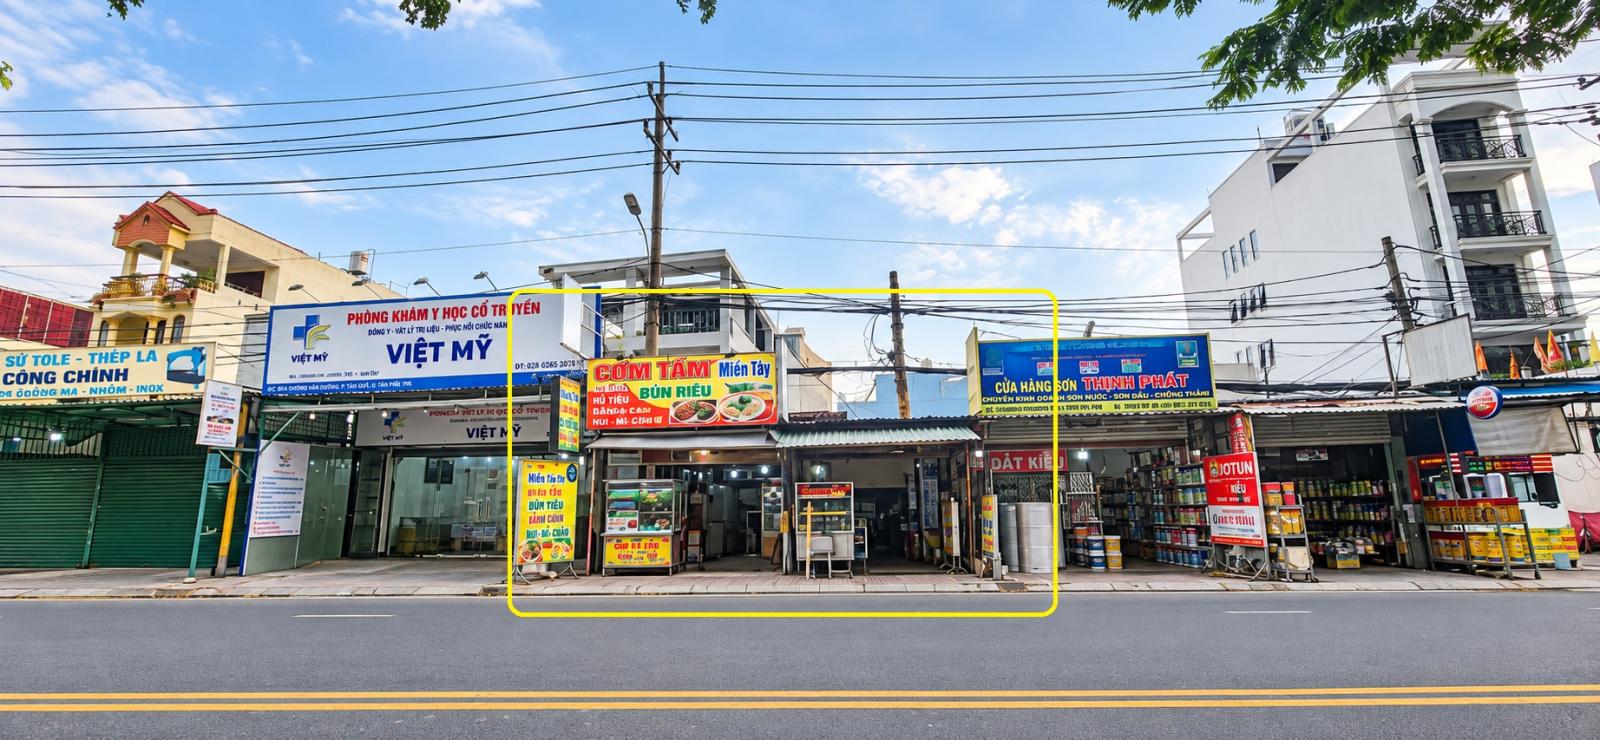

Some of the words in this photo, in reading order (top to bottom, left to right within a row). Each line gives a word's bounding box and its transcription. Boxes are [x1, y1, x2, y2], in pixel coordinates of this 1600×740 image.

[347, 309, 389, 325] PHÒNG
[392, 307, 429, 323] KHÁM
[432, 307, 440, 320] Y
[442, 306, 468, 321] HỌC
[32, 353, 71, 367] TOLE
[88, 349, 131, 365] THÉP
[291, 354, 312, 365] VIỆT
[314, 353, 329, 362] MỸ
[386, 337, 444, 369] VIỆT
[451, 333, 493, 361] MỸ
[2, 369, 57, 386] CÔNG
[63, 367, 129, 385] CHÍNH
[594, 359, 652, 382] CƠM
[656, 356, 711, 380] TẤM
[136, 384, 164, 393] INOX
[995, 376, 1018, 394] CỬA
[1020, 377, 1052, 393] HÀNG
[1082, 375, 1135, 393] THỊNH
[1139, 371, 1189, 390] PHÁT
[466, 424, 497, 440] VIỆT
[1220, 461, 1253, 476] JOTUN
